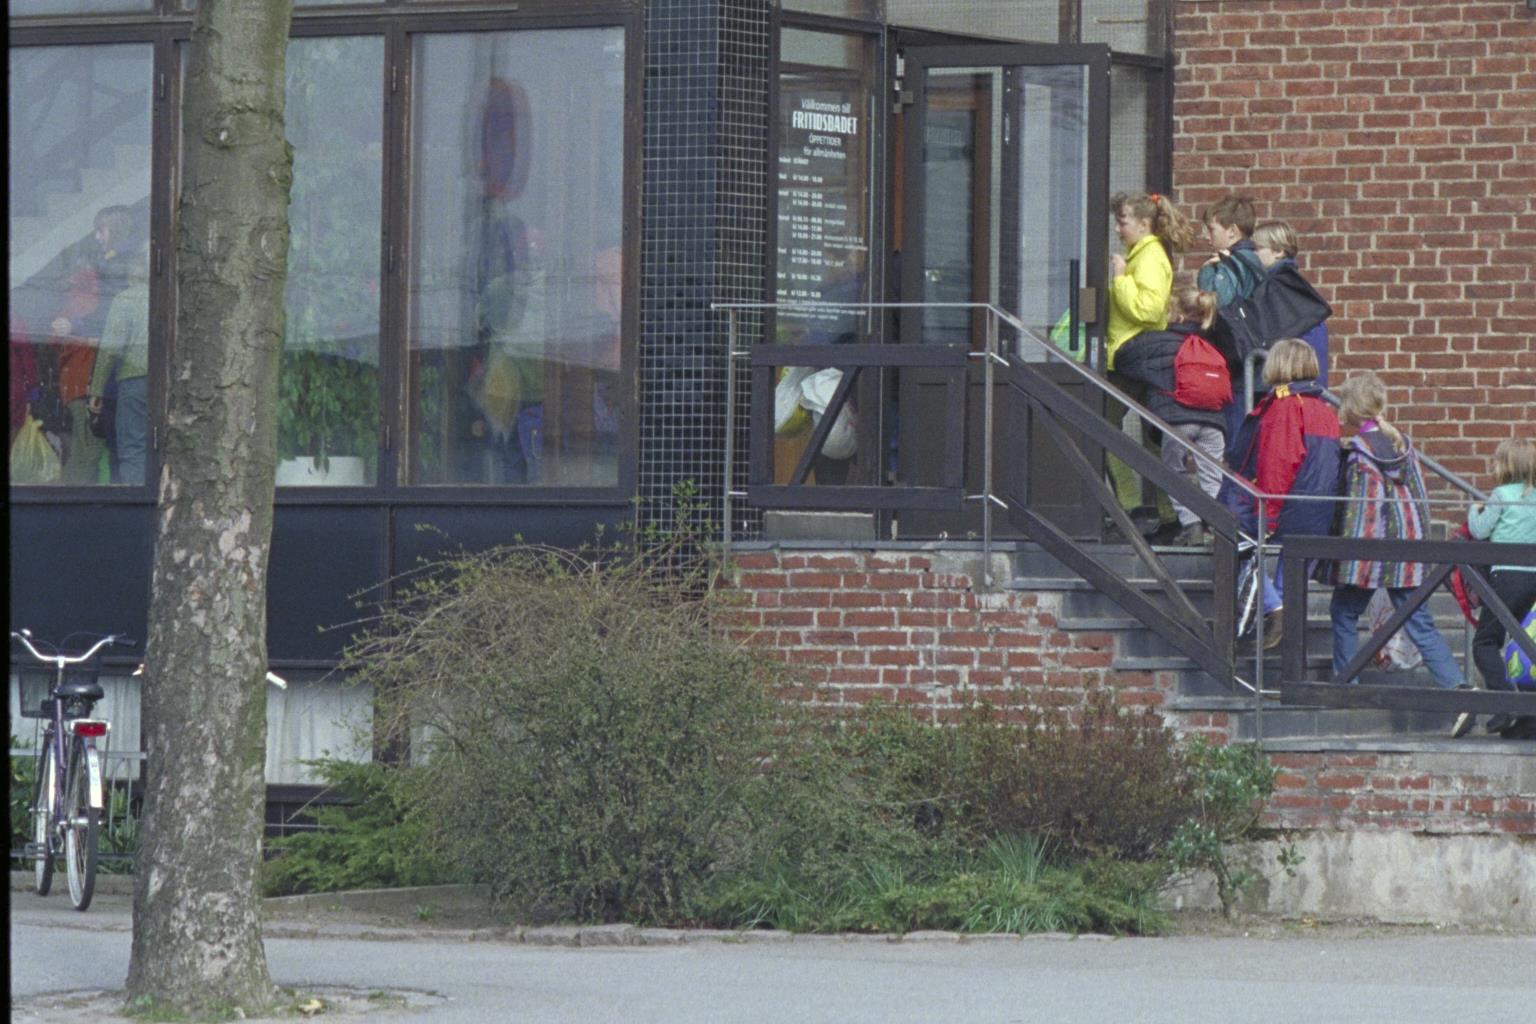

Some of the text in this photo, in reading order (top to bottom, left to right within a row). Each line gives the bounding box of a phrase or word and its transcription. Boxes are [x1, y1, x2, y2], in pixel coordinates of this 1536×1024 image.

[801, 98, 840, 112] Välkommen
[792, 110, 858, 134] FRITIDSBADET
[808, 132, 842, 146] ÖPPETTIDER
